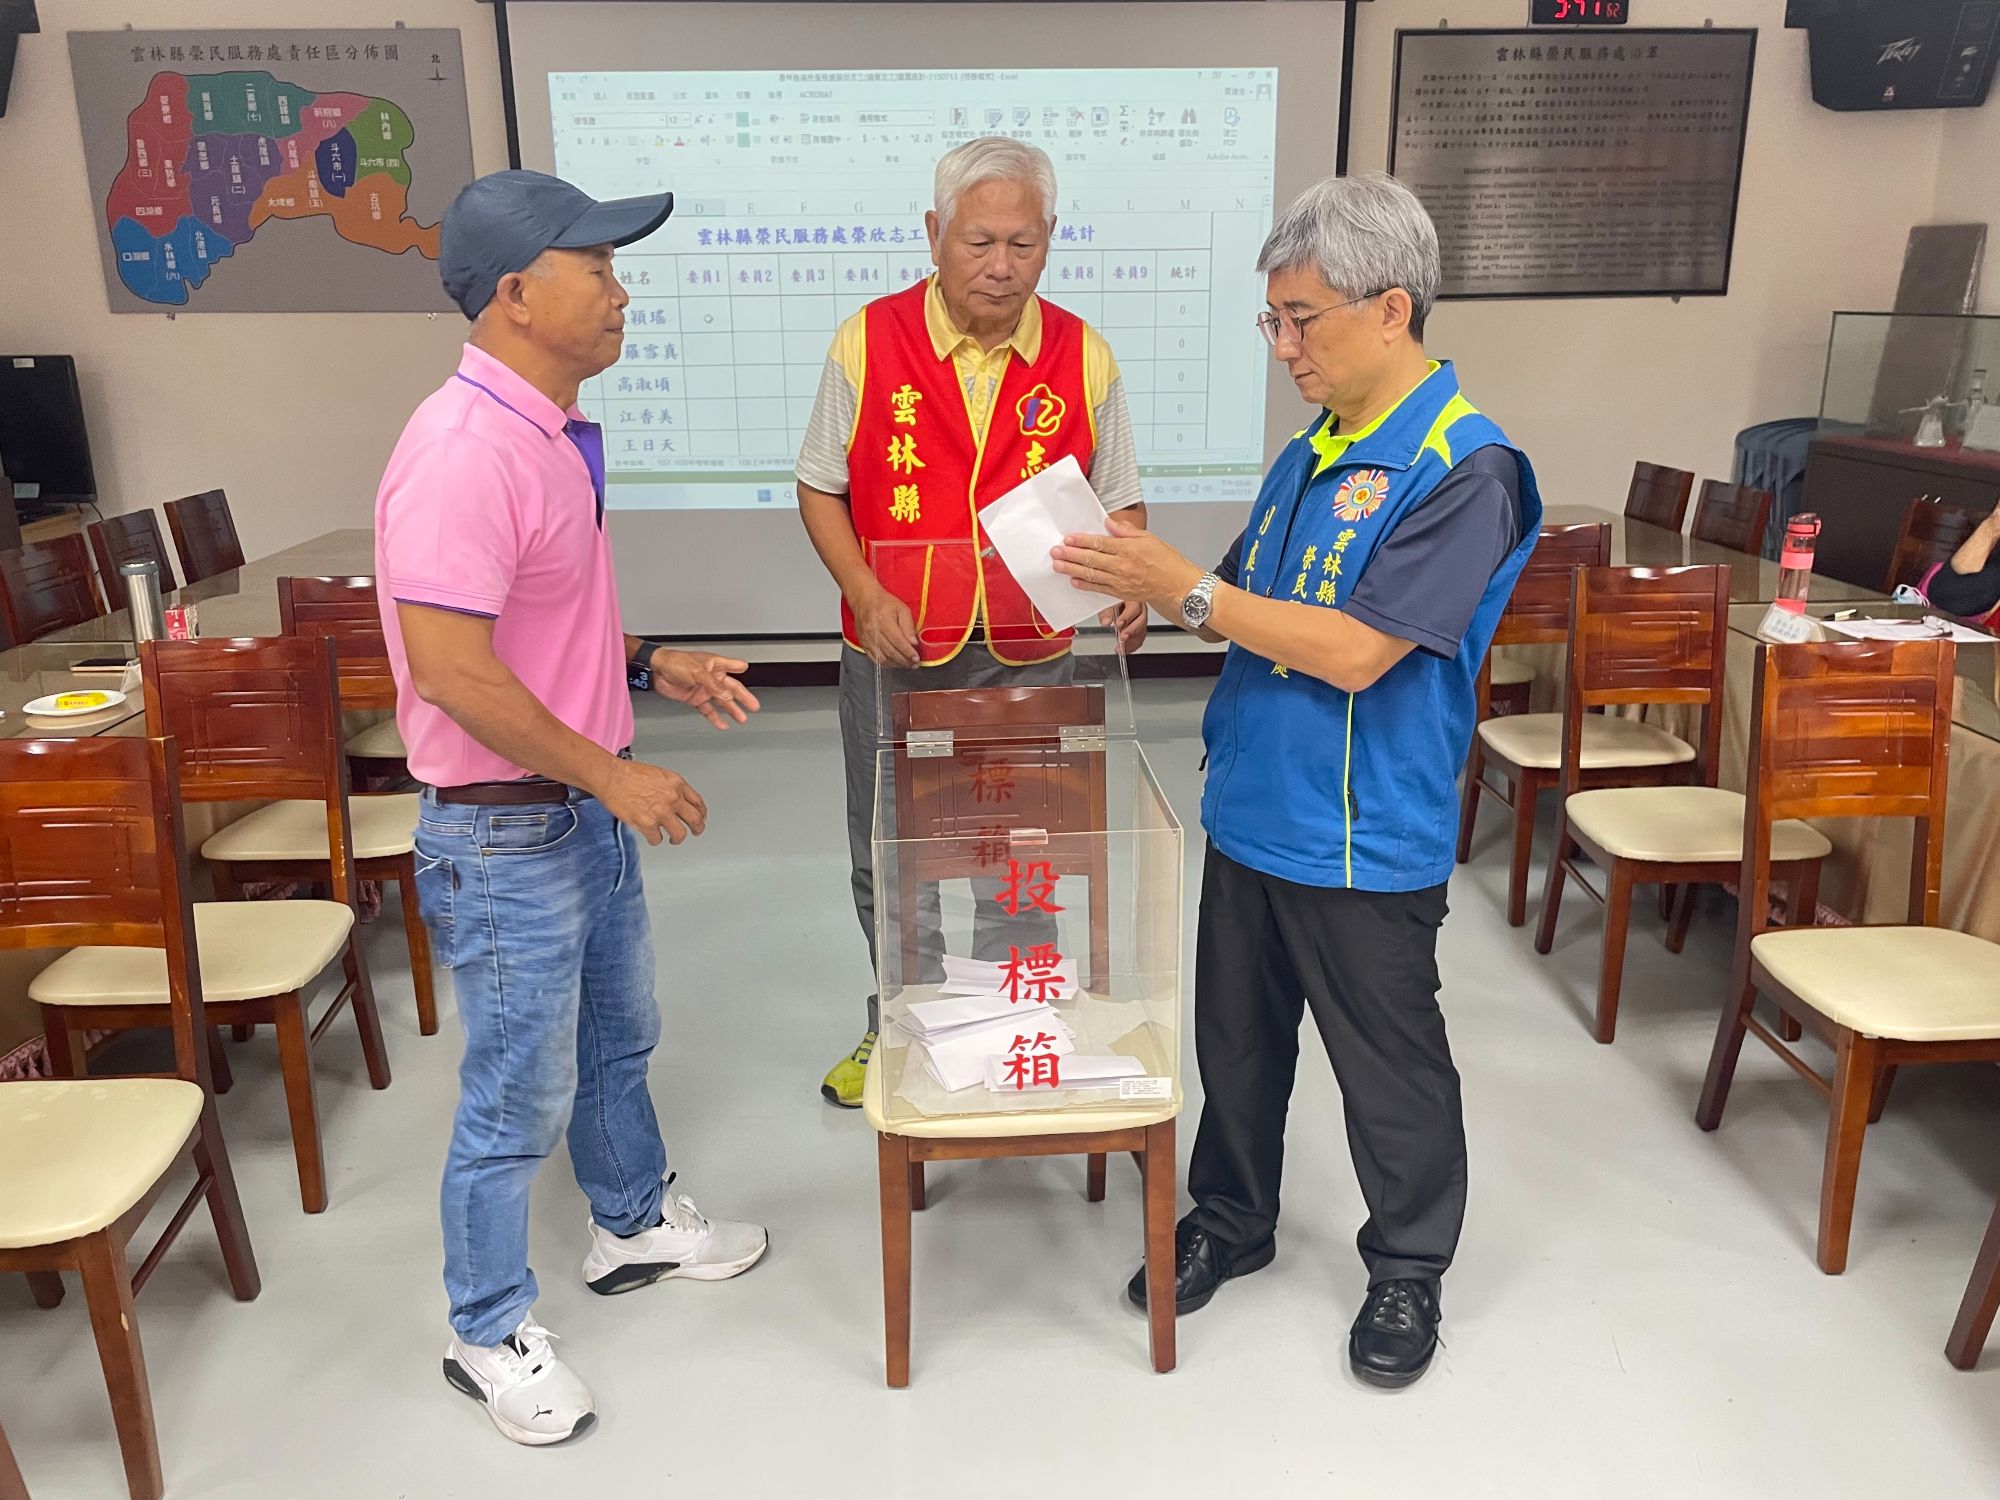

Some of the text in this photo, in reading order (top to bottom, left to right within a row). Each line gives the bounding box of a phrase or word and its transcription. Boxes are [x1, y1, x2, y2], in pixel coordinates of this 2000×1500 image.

[431, 54, 440, 64] 北
[695, 204, 704, 214] D
[747, 203, 754, 214] E
[800, 202, 808, 213] F
[854, 202, 864, 213] G
[909, 202, 918, 212] H
[1072, 200, 1080, 210] K
[1127, 200, 1134, 210] L
[1180, 200, 1191, 210] M
[1235, 198, 1245, 210] N
[698, 227, 924, 245] 雲林縣榮民服務處榮欣志工
[620, 270, 651, 286] 姓名
[687, 269, 721, 284] 委員1
[737, 268, 772, 284] 委員2
[791, 268, 826, 283] 委員3
[844, 267, 879, 282] 委員4
[1059, 266, 1094, 280] 委員8
[1112, 265, 1148, 280] 委員9
[1170, 266, 1198, 280] 統計
[620, 408, 674, 425] 江香美
[886, 384, 926, 524] 雲林縣
[1315, 528, 1356, 605] 雲林縣
[994, 858, 1066, 1090] 投標箱
